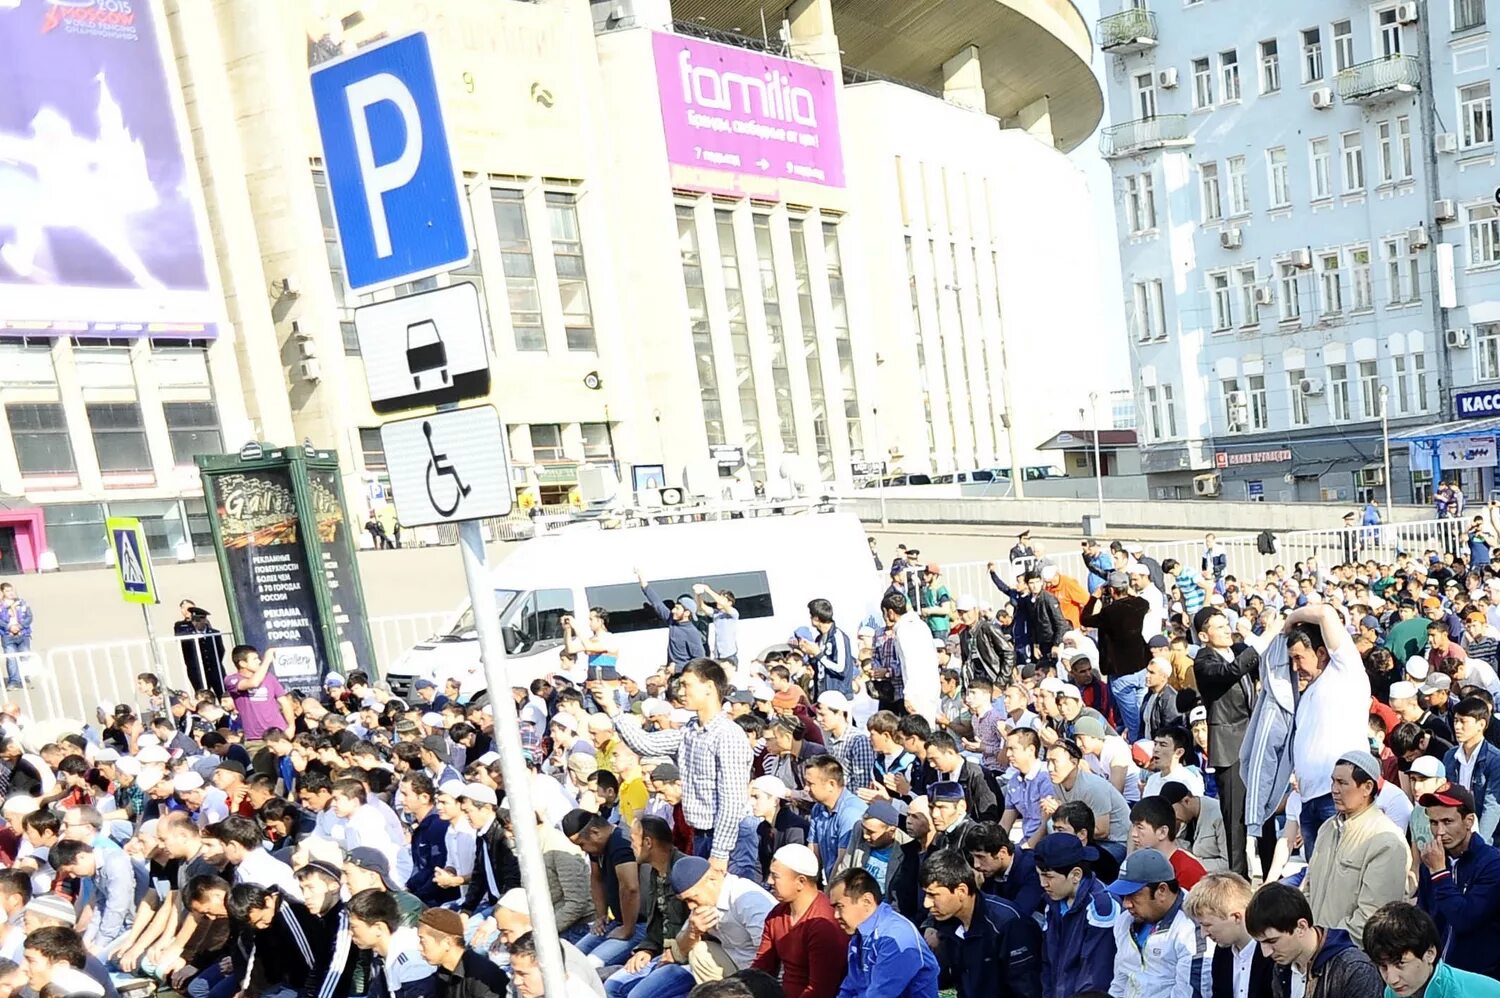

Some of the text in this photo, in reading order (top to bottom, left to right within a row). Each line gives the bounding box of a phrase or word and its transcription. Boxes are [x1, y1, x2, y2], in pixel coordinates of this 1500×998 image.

[60, 6, 135, 25] MOSCOW
[678, 49, 817, 128] familia
[344, 72, 424, 259] P
[273, 582, 301, 592] ГОРОДАХ
[263, 607, 301, 618] РЕКЛАМА
[273, 618, 309, 629] ФОРМАТЕ
[267, 629, 301, 641] ГОРОДА
[278, 653, 312, 669] Gallery
